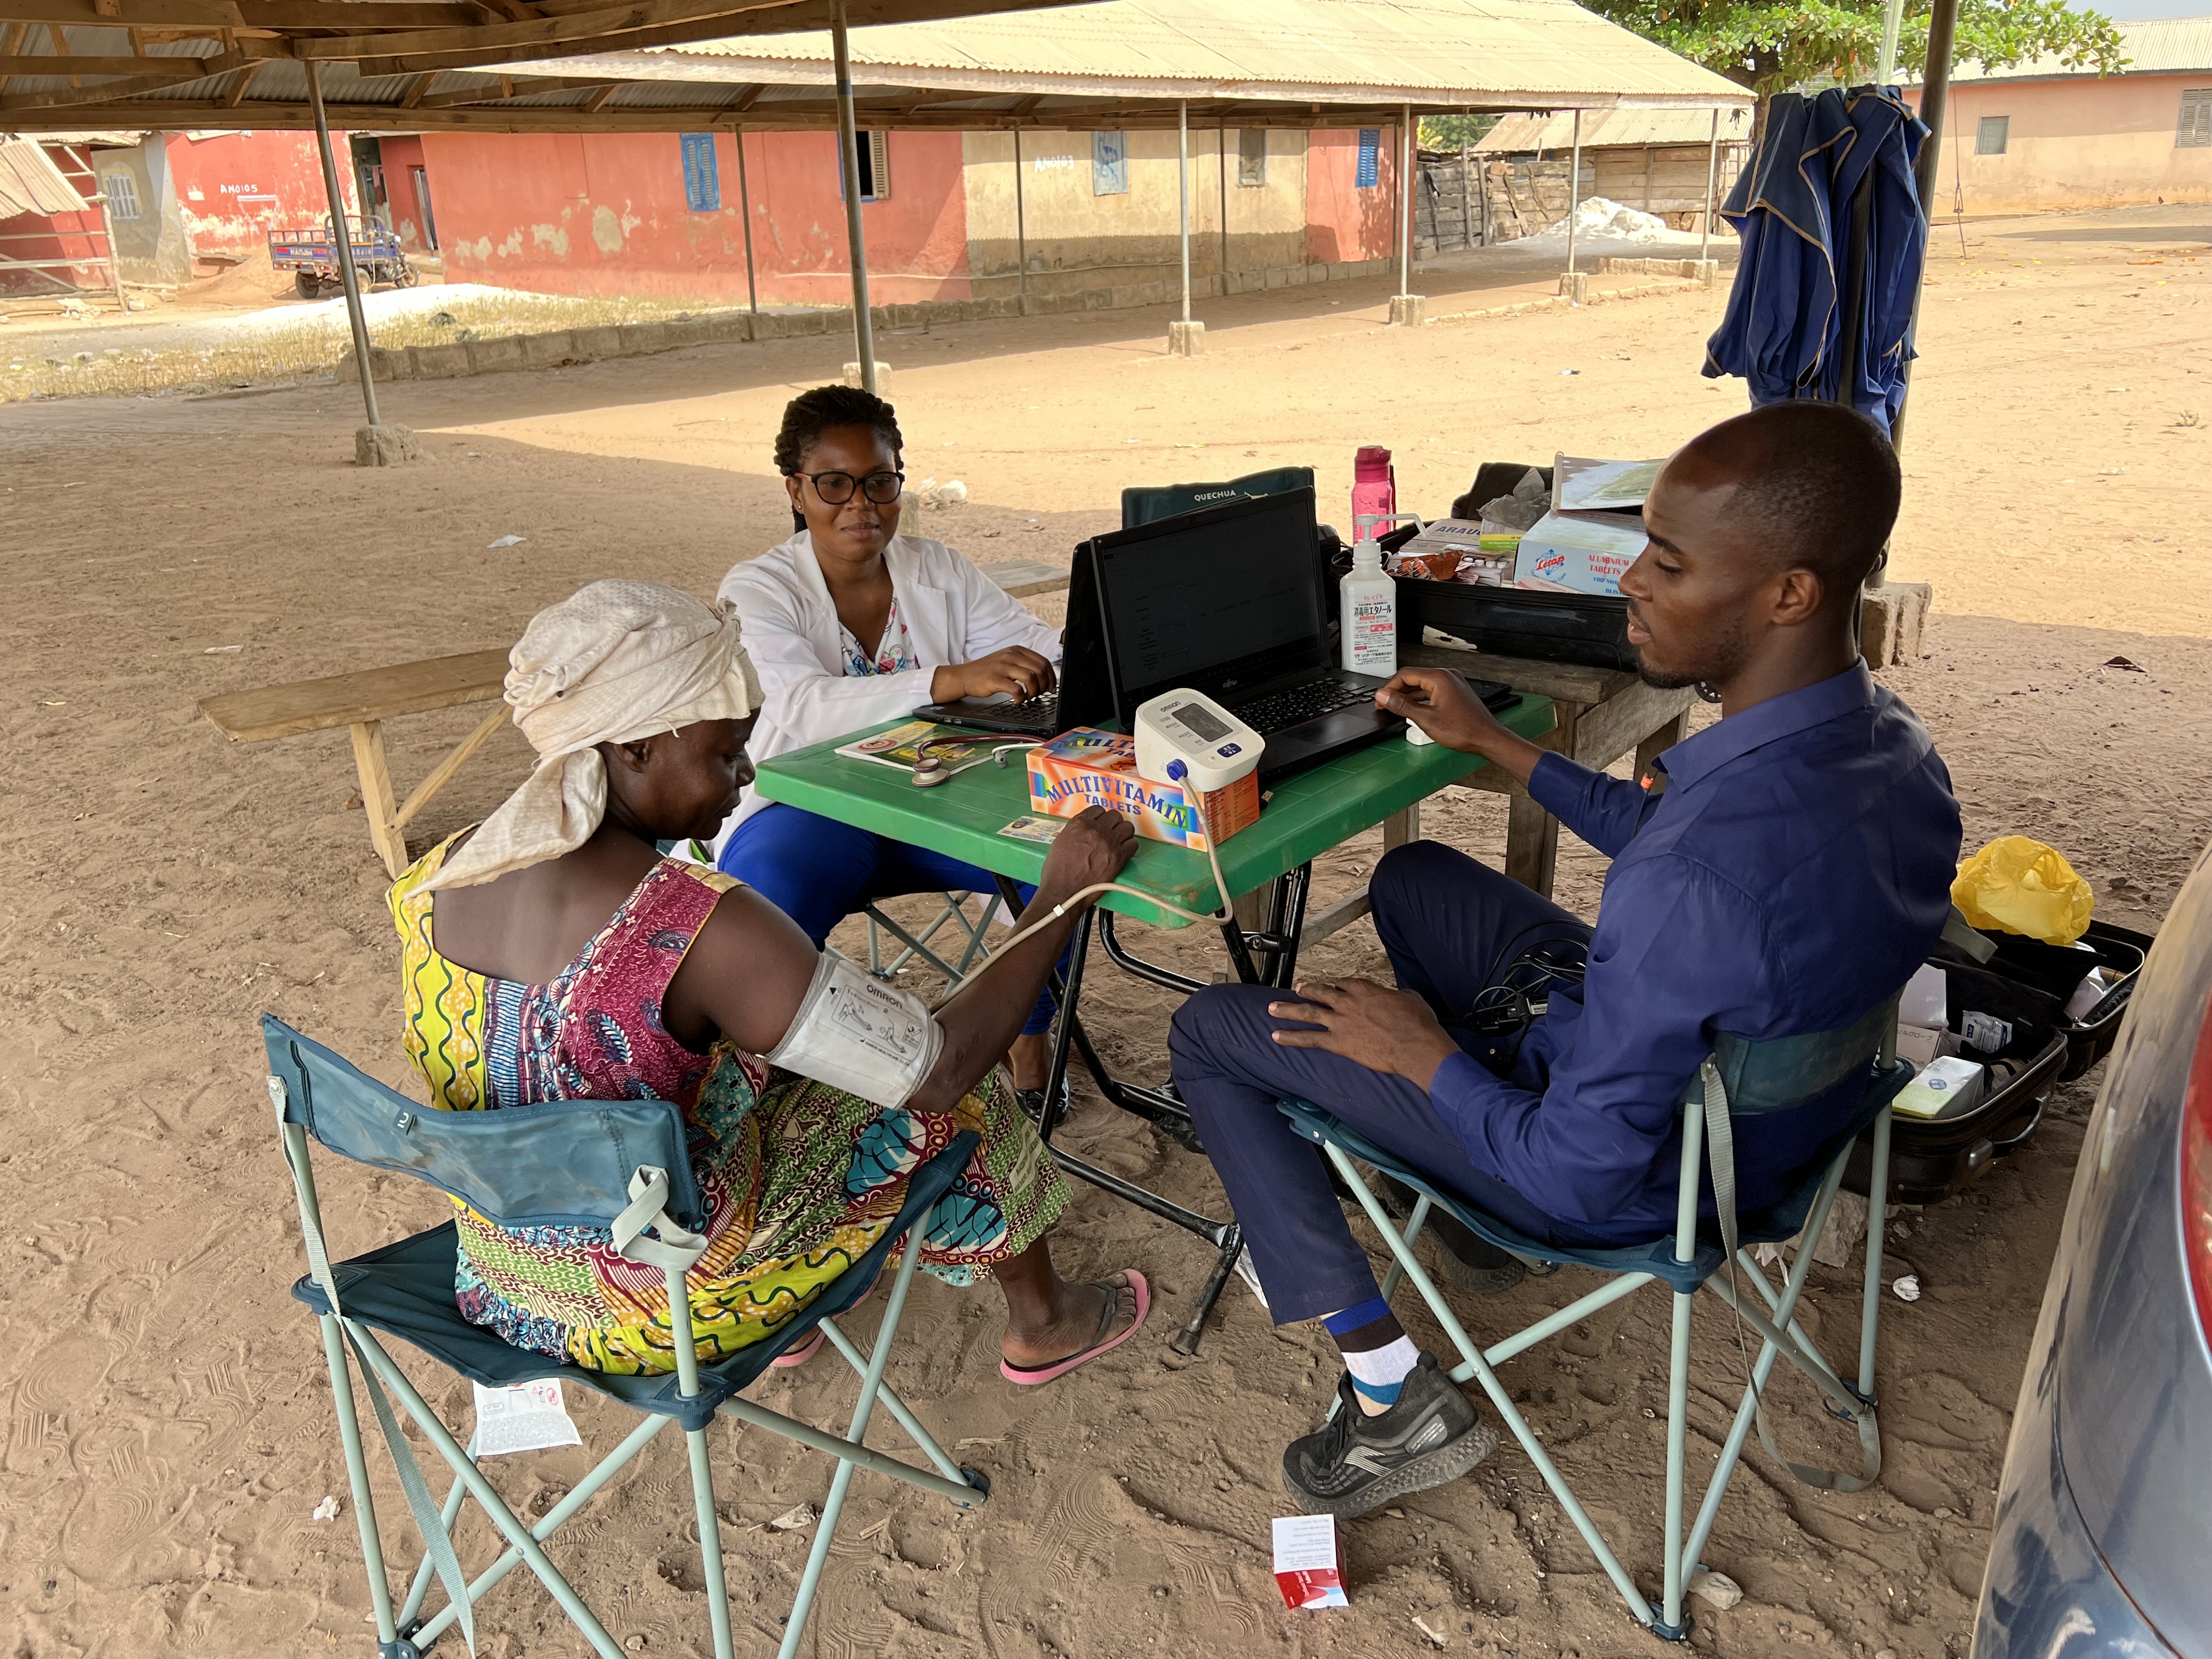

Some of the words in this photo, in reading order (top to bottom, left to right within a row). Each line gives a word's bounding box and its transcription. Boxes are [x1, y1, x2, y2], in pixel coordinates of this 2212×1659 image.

[1194, 489, 1236, 501] QUECHUA
[1590, 564, 1621, 575] TABLETS
[1160, 701, 1181, 712] OMRON
[1046, 775, 1187, 829] MULTIVITAMIN
[1084, 793, 1142, 815] TABLETS
[867, 984, 903, 1009] OMRON
